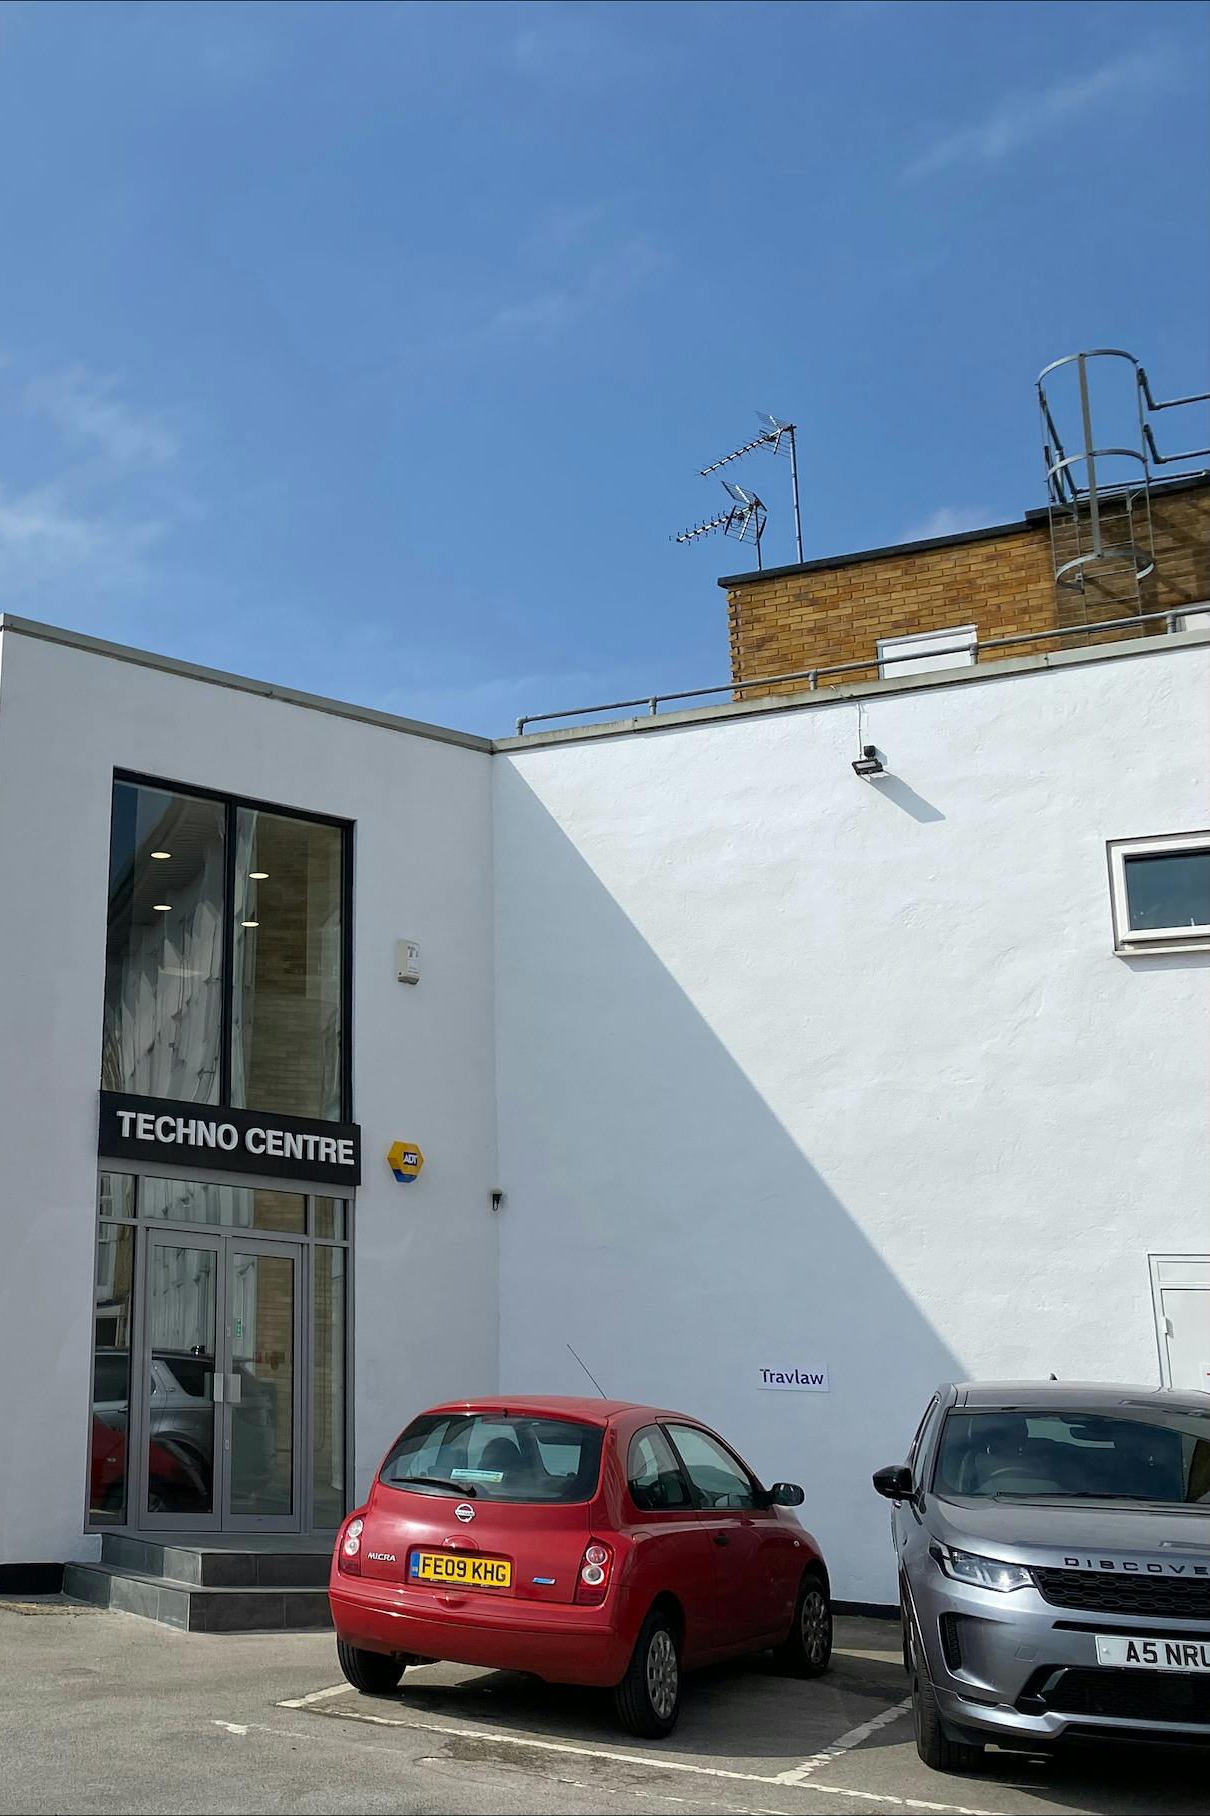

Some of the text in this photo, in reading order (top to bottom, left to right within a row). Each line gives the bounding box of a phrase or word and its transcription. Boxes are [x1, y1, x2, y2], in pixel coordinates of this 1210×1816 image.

[116, 1110, 355, 1165] TECHNO CENTRE
[402, 1153, 418, 1165] ADT
[759, 1368, 824, 1385] Travlaw
[367, 1552, 396, 1562] MICRA
[422, 1556, 506, 1582] FE09 KHG
[1126, 1641, 1158, 1664] A5
